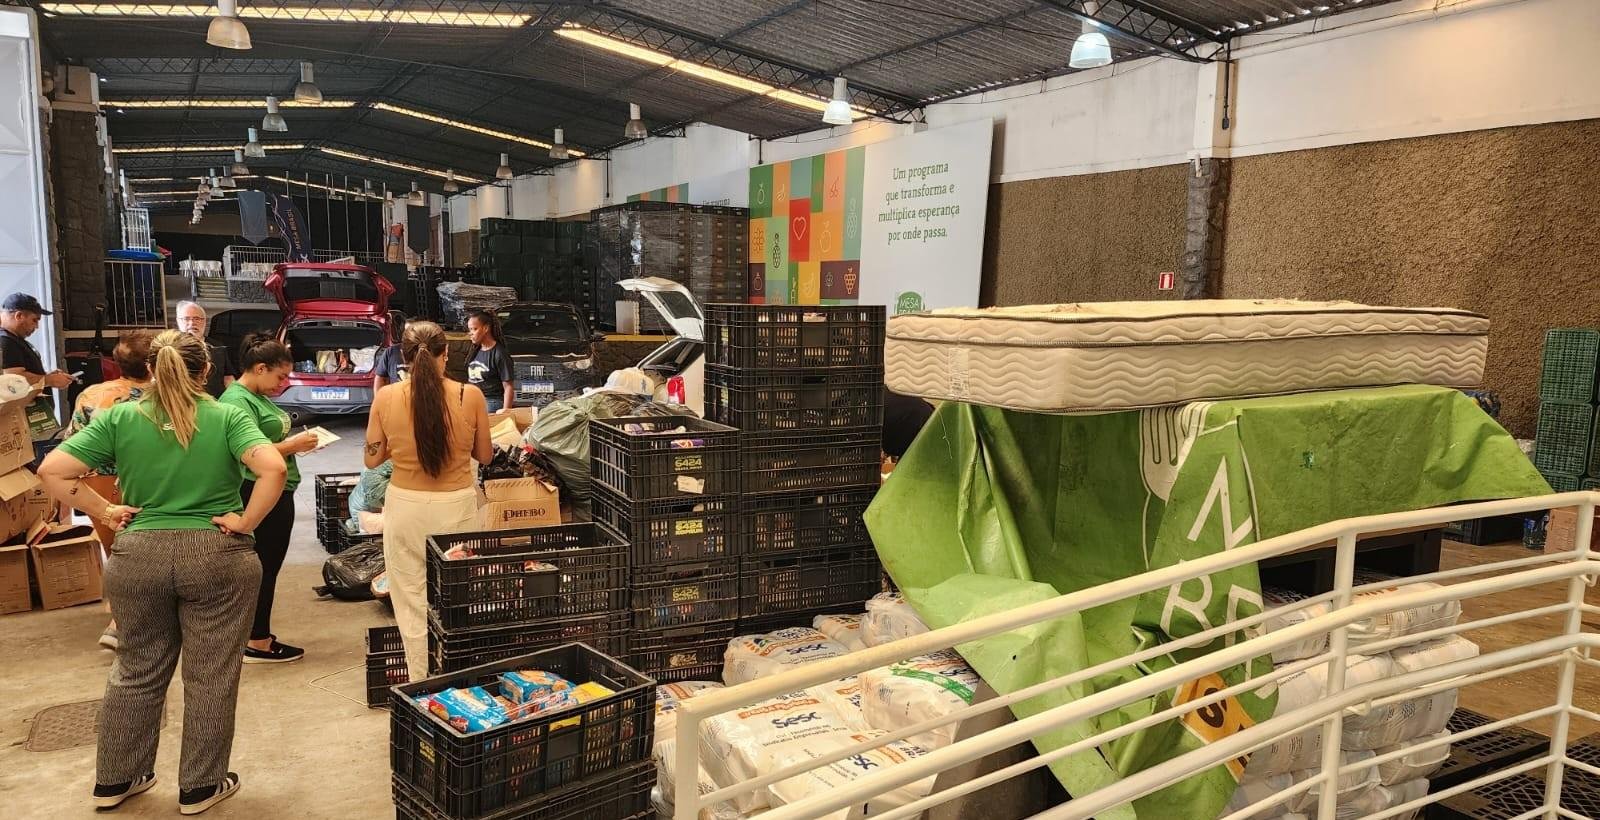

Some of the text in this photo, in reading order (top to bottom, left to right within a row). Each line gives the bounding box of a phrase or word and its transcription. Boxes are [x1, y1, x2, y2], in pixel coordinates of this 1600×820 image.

[893, 163, 949, 182] Um programa
[885, 184, 955, 205] que transforma e
[878, 205, 960, 224] multiplica esperança
[888, 227, 948, 245] por onde passa.
[530, 365, 545, 376] FIAT
[674, 458, 703, 468] 6424
